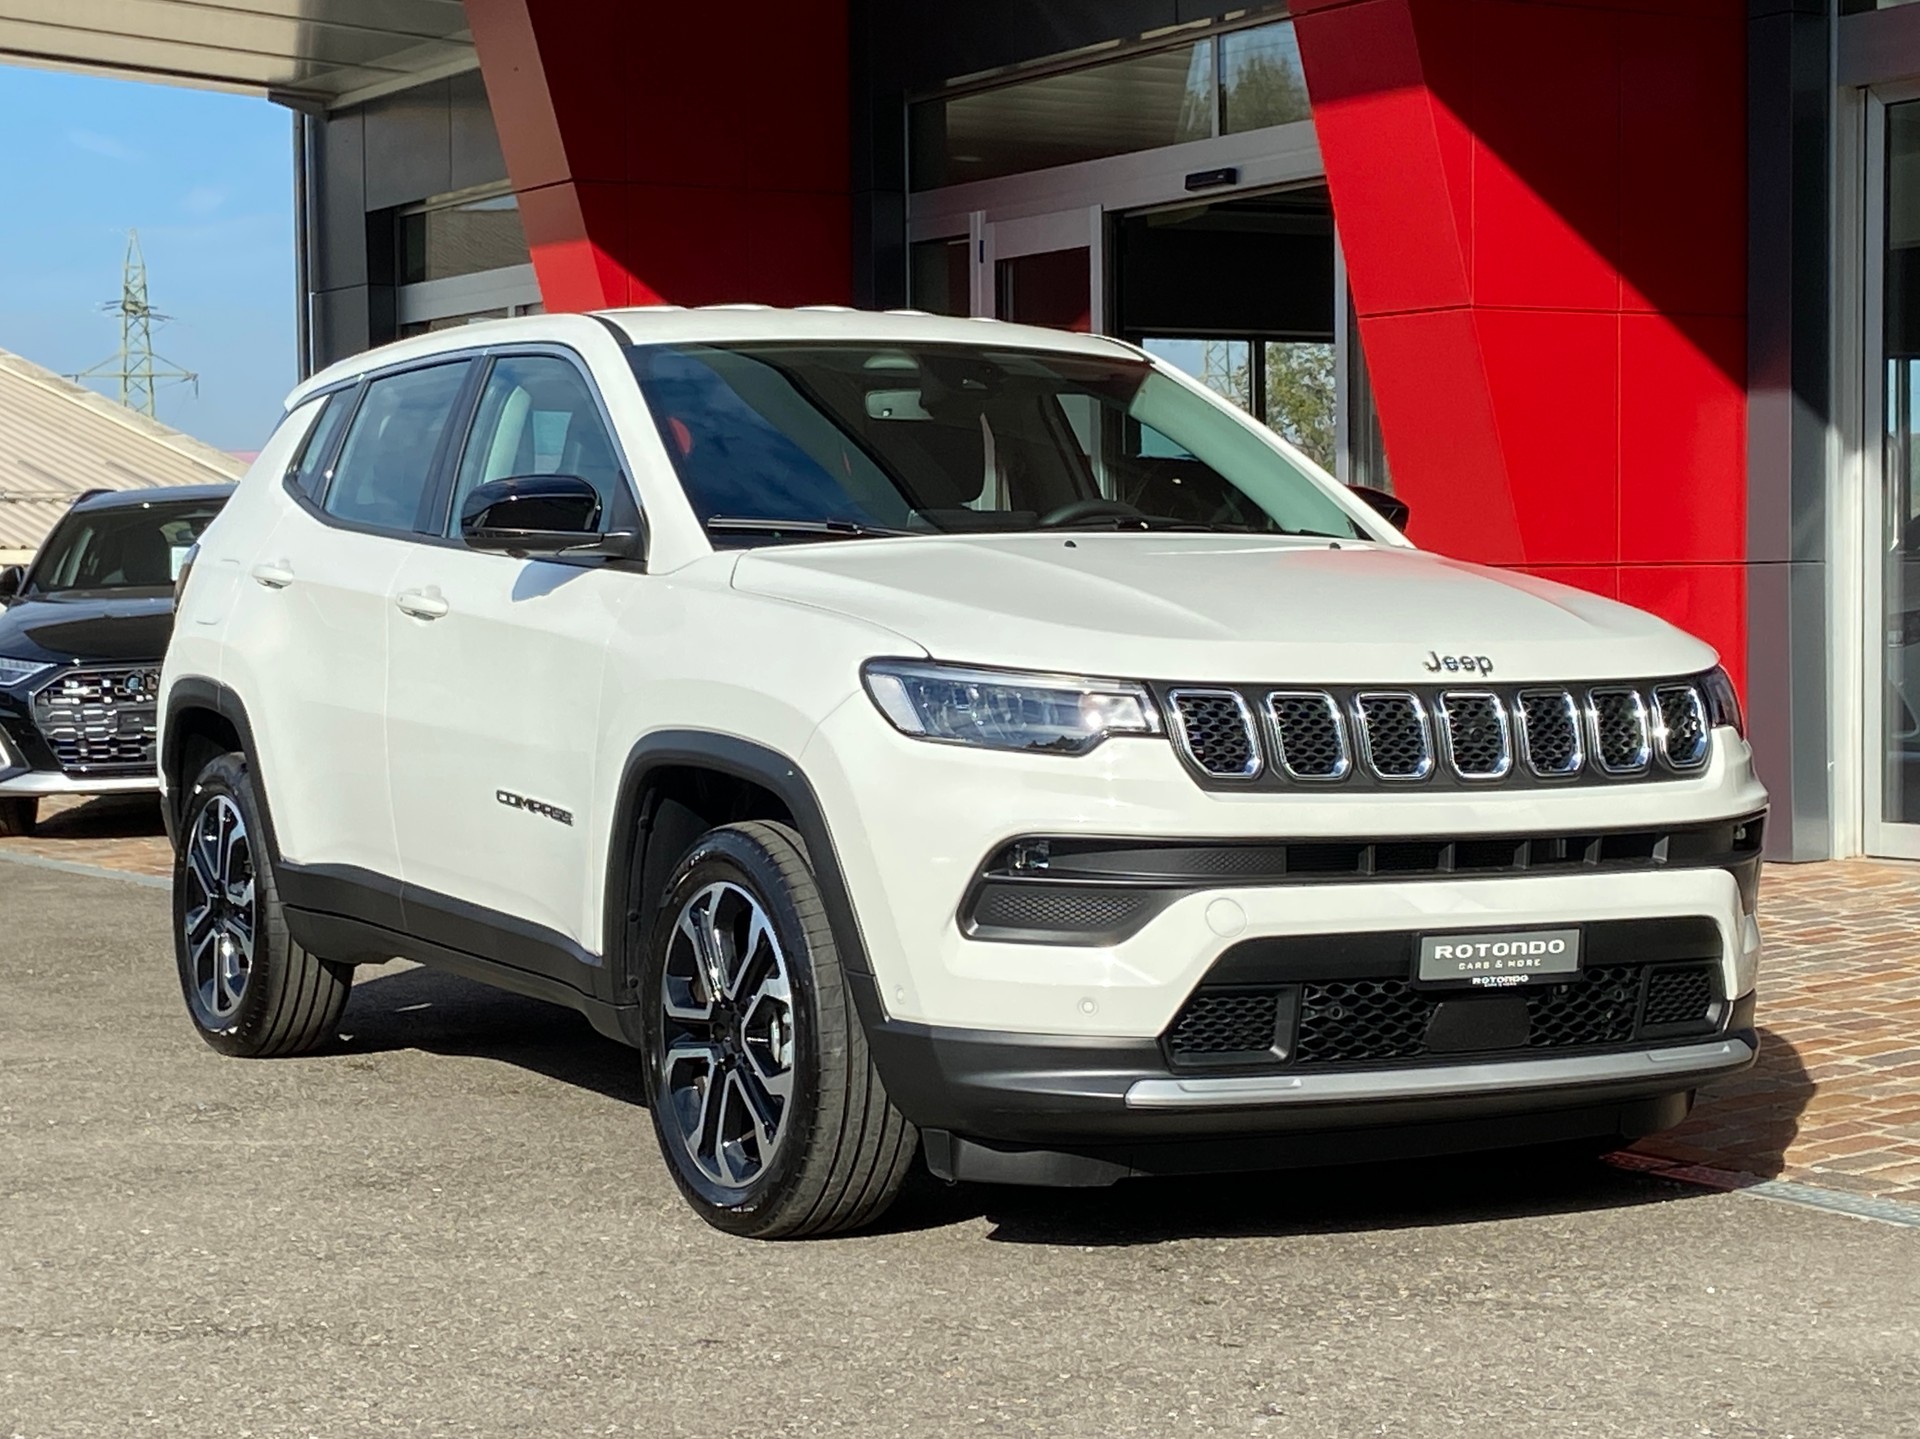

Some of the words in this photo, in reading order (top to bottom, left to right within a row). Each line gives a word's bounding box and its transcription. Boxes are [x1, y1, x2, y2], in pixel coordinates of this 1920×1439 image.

[1422, 650, 1494, 677] Jeep
[496, 789, 574, 827] COMPASS
[1434, 939, 1566, 960] ROTONDO
[1458, 961, 1490, 971] CARS
[1494, 959, 1504, 969] &
[1507, 958, 1542, 968] MORE
[1471, 974, 1529, 985] ROTONDO
